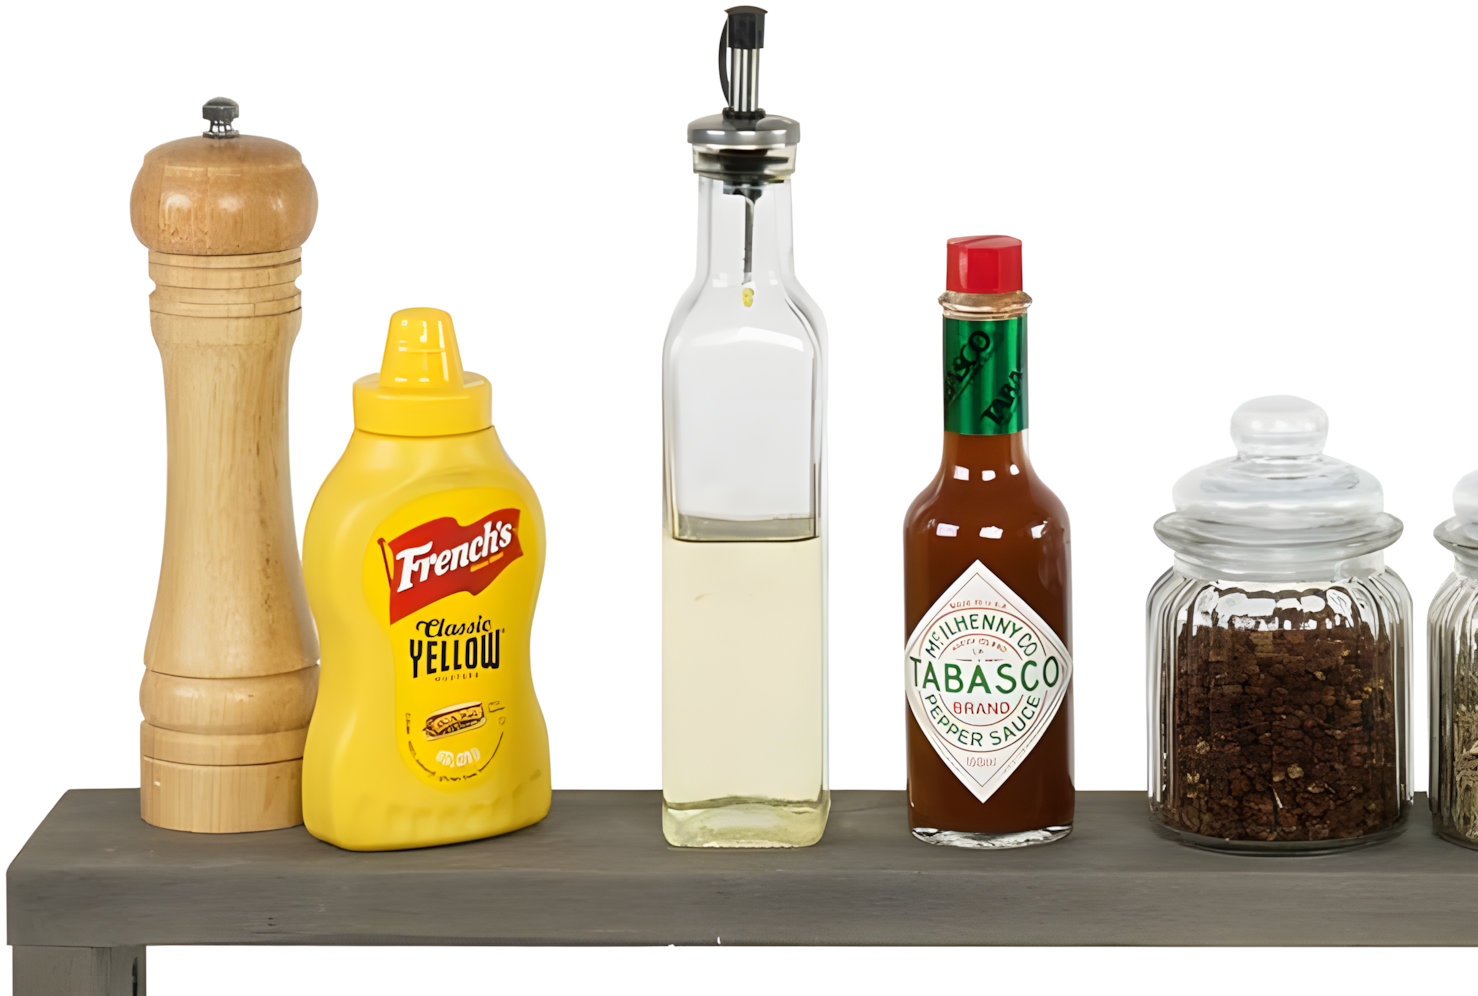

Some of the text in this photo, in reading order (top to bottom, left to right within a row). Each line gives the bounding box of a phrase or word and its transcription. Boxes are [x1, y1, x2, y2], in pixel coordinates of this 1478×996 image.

[395, 520, 512, 593] French's
[416, 615, 492, 638] Classic
[409, 629, 500, 678] YELLOW
[909, 656, 1060, 694] TABASCO
[925, 694, 1041, 747] PEPPER SAUCE
[953, 701, 1010, 715] BRAND
